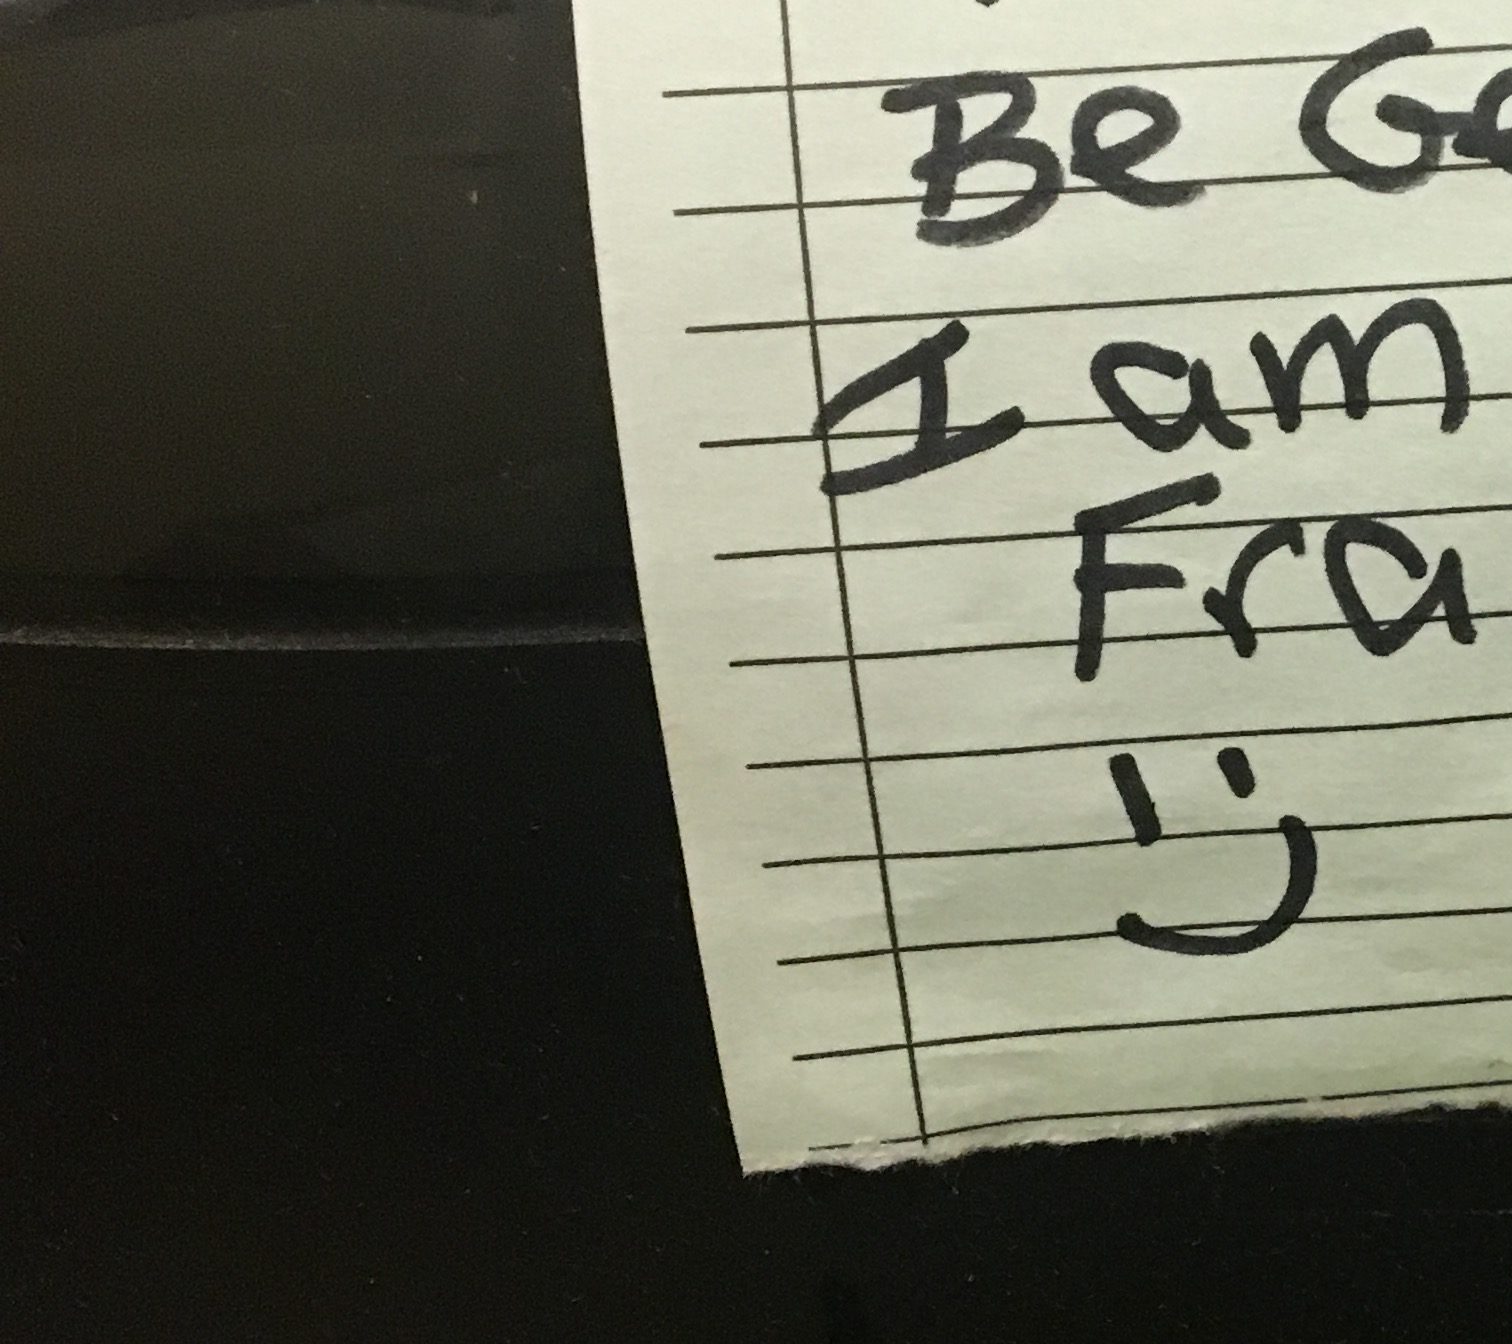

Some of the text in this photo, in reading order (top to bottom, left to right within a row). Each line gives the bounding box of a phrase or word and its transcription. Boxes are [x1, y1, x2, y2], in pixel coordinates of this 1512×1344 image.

[881, 68, 1207, 247] Be
[812, 297, 1471, 496] I am
